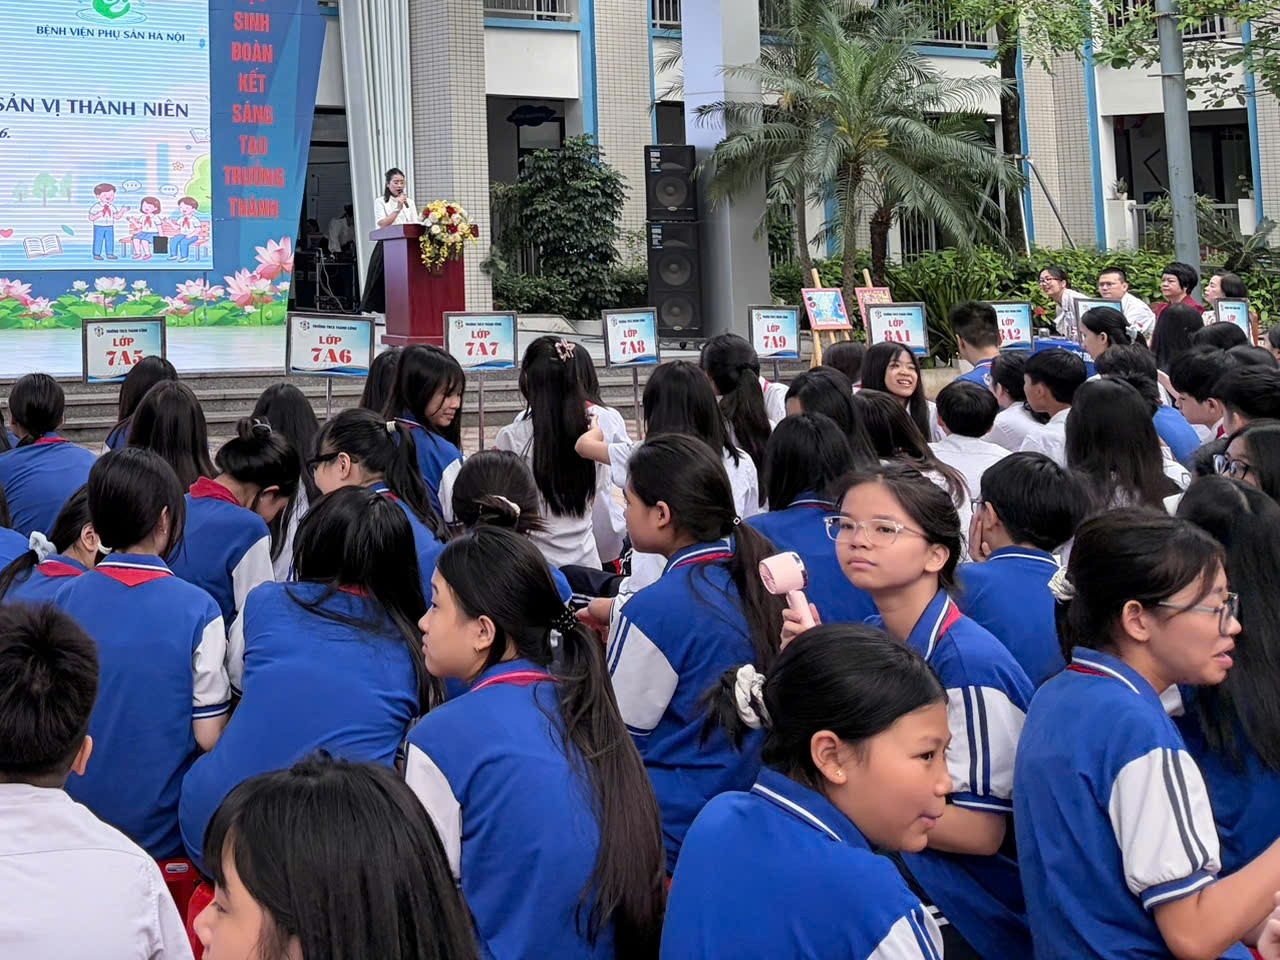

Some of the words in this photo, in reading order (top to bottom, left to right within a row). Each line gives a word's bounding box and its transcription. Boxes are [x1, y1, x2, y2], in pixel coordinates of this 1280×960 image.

[233, 11, 271, 33] SINH
[36, 25, 66, 37] BỆNH
[70, 26, 94, 38] VIỆN
[98, 28, 120, 40] PHỤ
[124, 28, 145, 40] SẢN
[148, 30, 163, 41] HÀ
[166, 31, 185, 42] NỘI
[231, 39, 273, 64] ĐOÀN
[239, 66, 266, 93] KẾT
[42, 98, 61, 117] VỊ
[67, 96, 136, 116] THÀNH
[143, 100, 189, 118] NIÊN
[232, 100, 274, 126] SÁNG
[239, 134, 269, 159] TẠO
[228, 193, 280, 219] THÀNH
[767, 322, 780, 332] LỚP
[888, 317, 904, 327] LỚP
[319, 334, 342, 345] LỚP
[471, 328, 490, 339] LỚP
[624, 327, 638, 338] LỚP
[884, 330, 911, 342] 8A1
[113, 335, 134, 347] LỚP
[620, 340, 646, 355] 7A8
[763, 335, 787, 349] 7A9
[311, 347, 352, 364] 7A6
[465, 342, 499, 356] 7A7
[106, 350, 144, 366] 7A5
